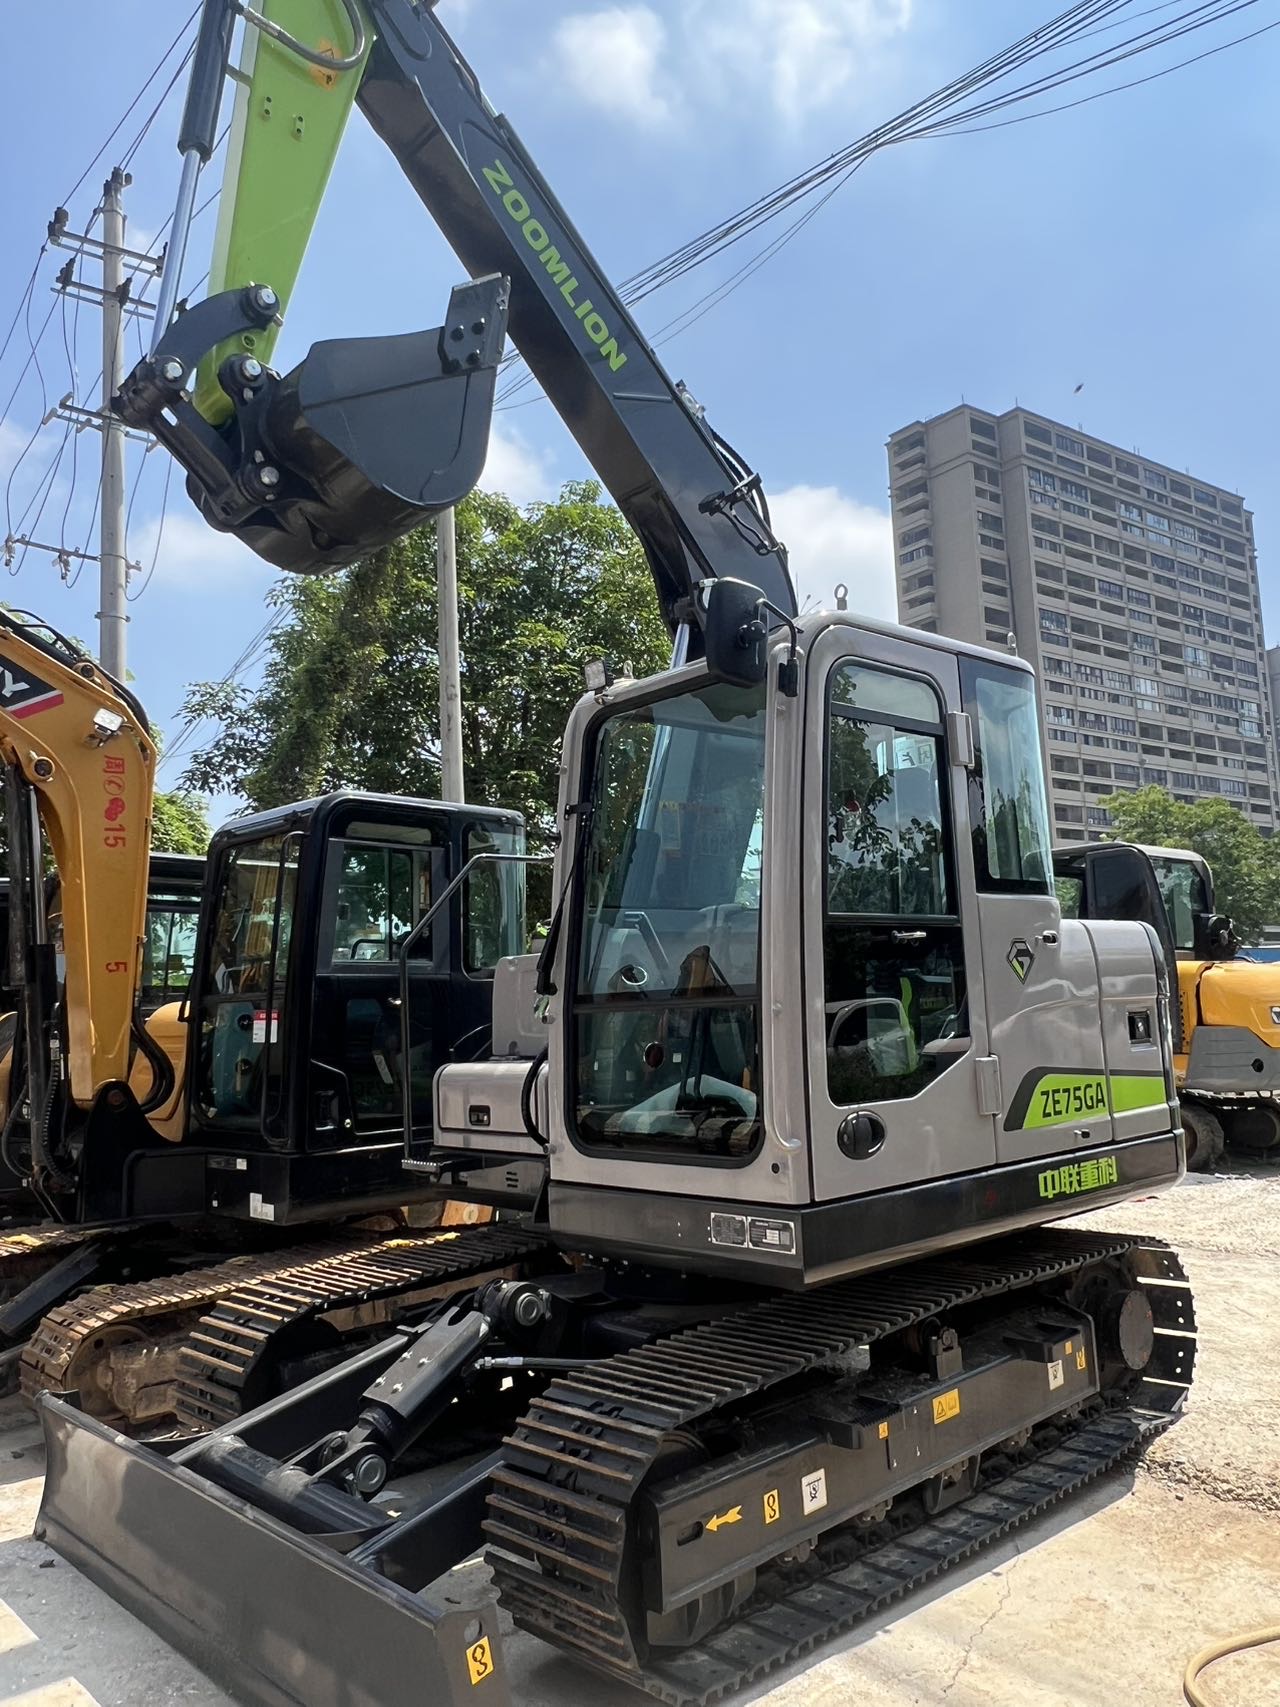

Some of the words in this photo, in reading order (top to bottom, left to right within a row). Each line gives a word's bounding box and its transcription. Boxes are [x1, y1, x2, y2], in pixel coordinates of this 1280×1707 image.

[481, 159, 628, 372] ZOOMLION
[0, 665, 31, 698] Y
[104, 824, 126, 849] 15
[105, 960, 128, 974] 5
[1040, 1082, 1106, 1118] ZE75GA
[1038, 1155, 1118, 1198] 中联重科
